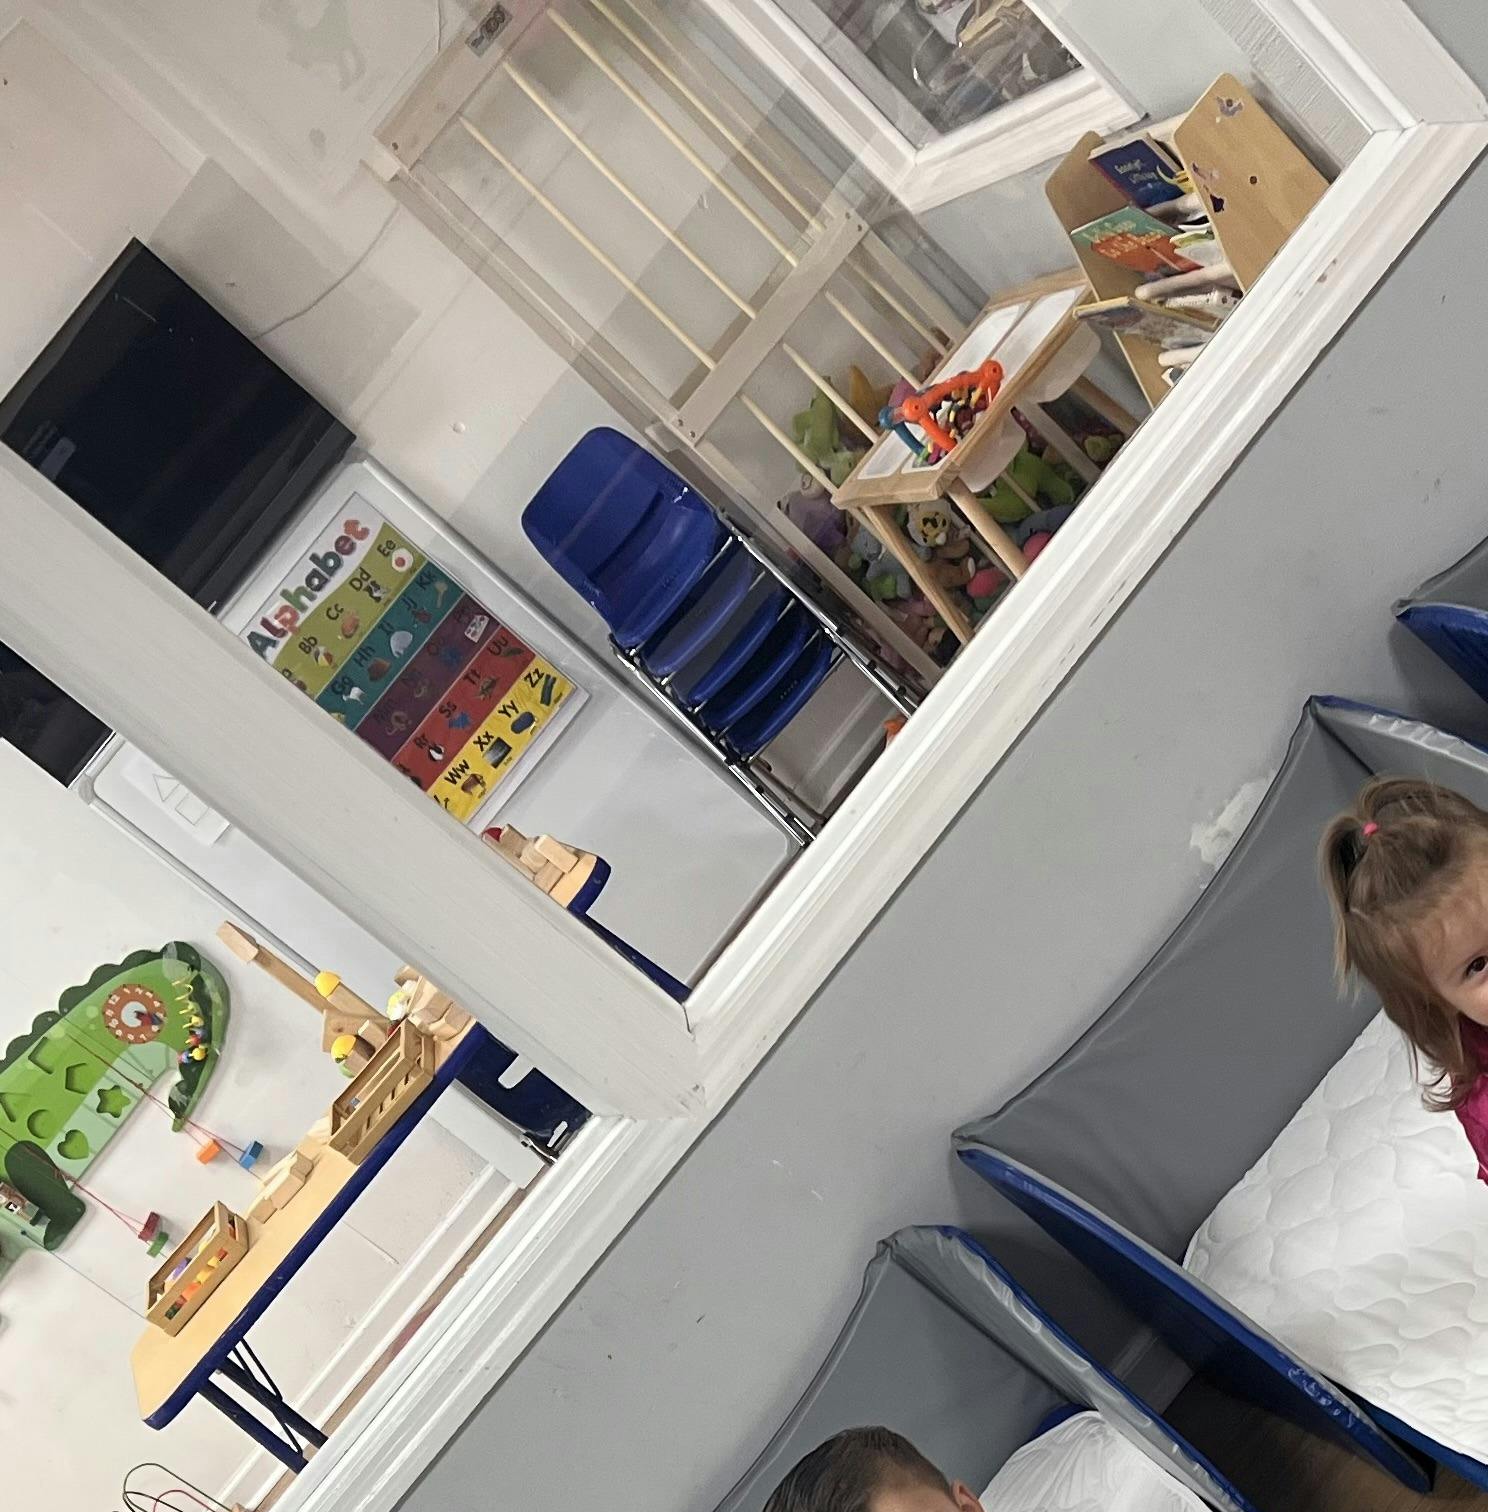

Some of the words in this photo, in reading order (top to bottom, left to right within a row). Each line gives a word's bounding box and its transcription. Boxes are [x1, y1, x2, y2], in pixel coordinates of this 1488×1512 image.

[247, 519, 370, 662] Alphabet
[298, 636, 318, 655] Bb
[325, 603, 344, 621] Cc
[350, 567, 371, 591] Dd
[377, 539, 397, 557] Ee
[353, 646, 376, 668] Hh
[416, 570, 437, 591] Kk
[438, 701, 457, 719] Ss
[463, 669, 482, 685] Tt
[487, 636, 508, 656] Uu
[443, 759, 470, 785] Ww
[473, 731, 494, 752] Xx
[498, 700, 520, 718] Yy
[523, 668, 545, 688] Zz
